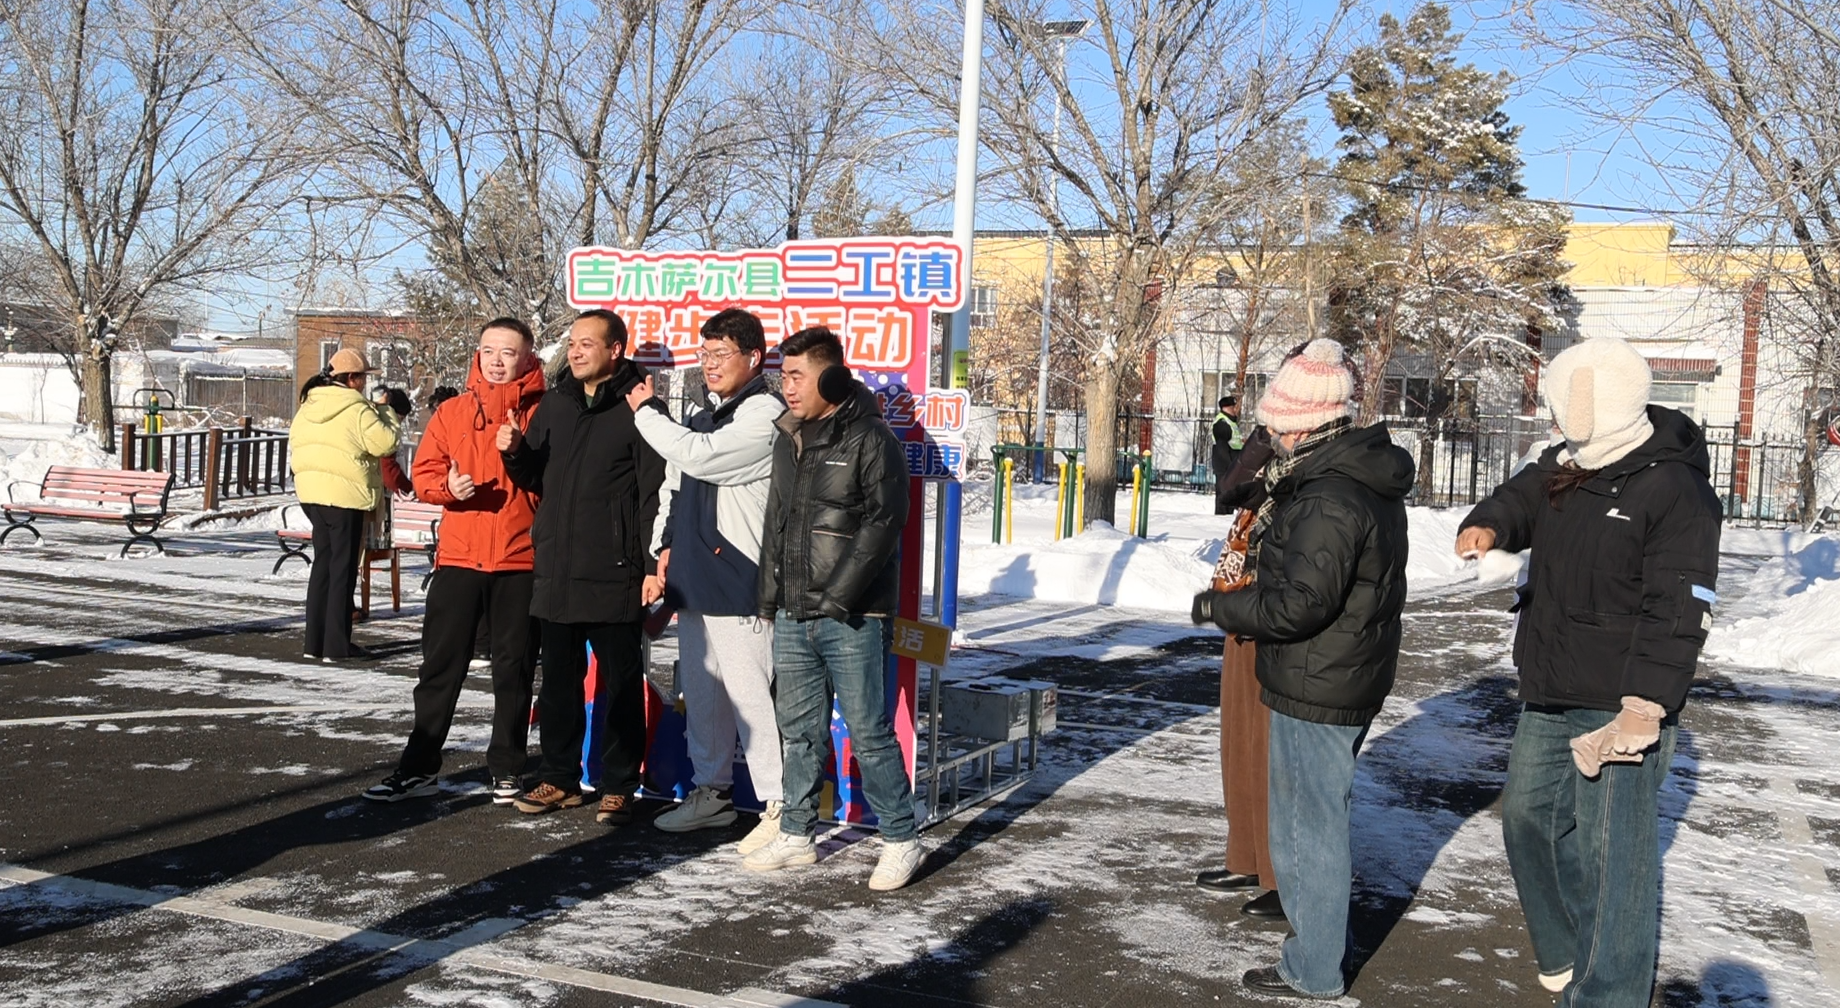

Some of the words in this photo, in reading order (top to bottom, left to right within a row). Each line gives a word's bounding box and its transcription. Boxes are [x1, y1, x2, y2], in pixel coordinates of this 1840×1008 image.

[576, 250, 952, 298] 吉木萨尔县二工镇
[877, 393, 964, 428] 乡村
[891, 625, 925, 652] 活
